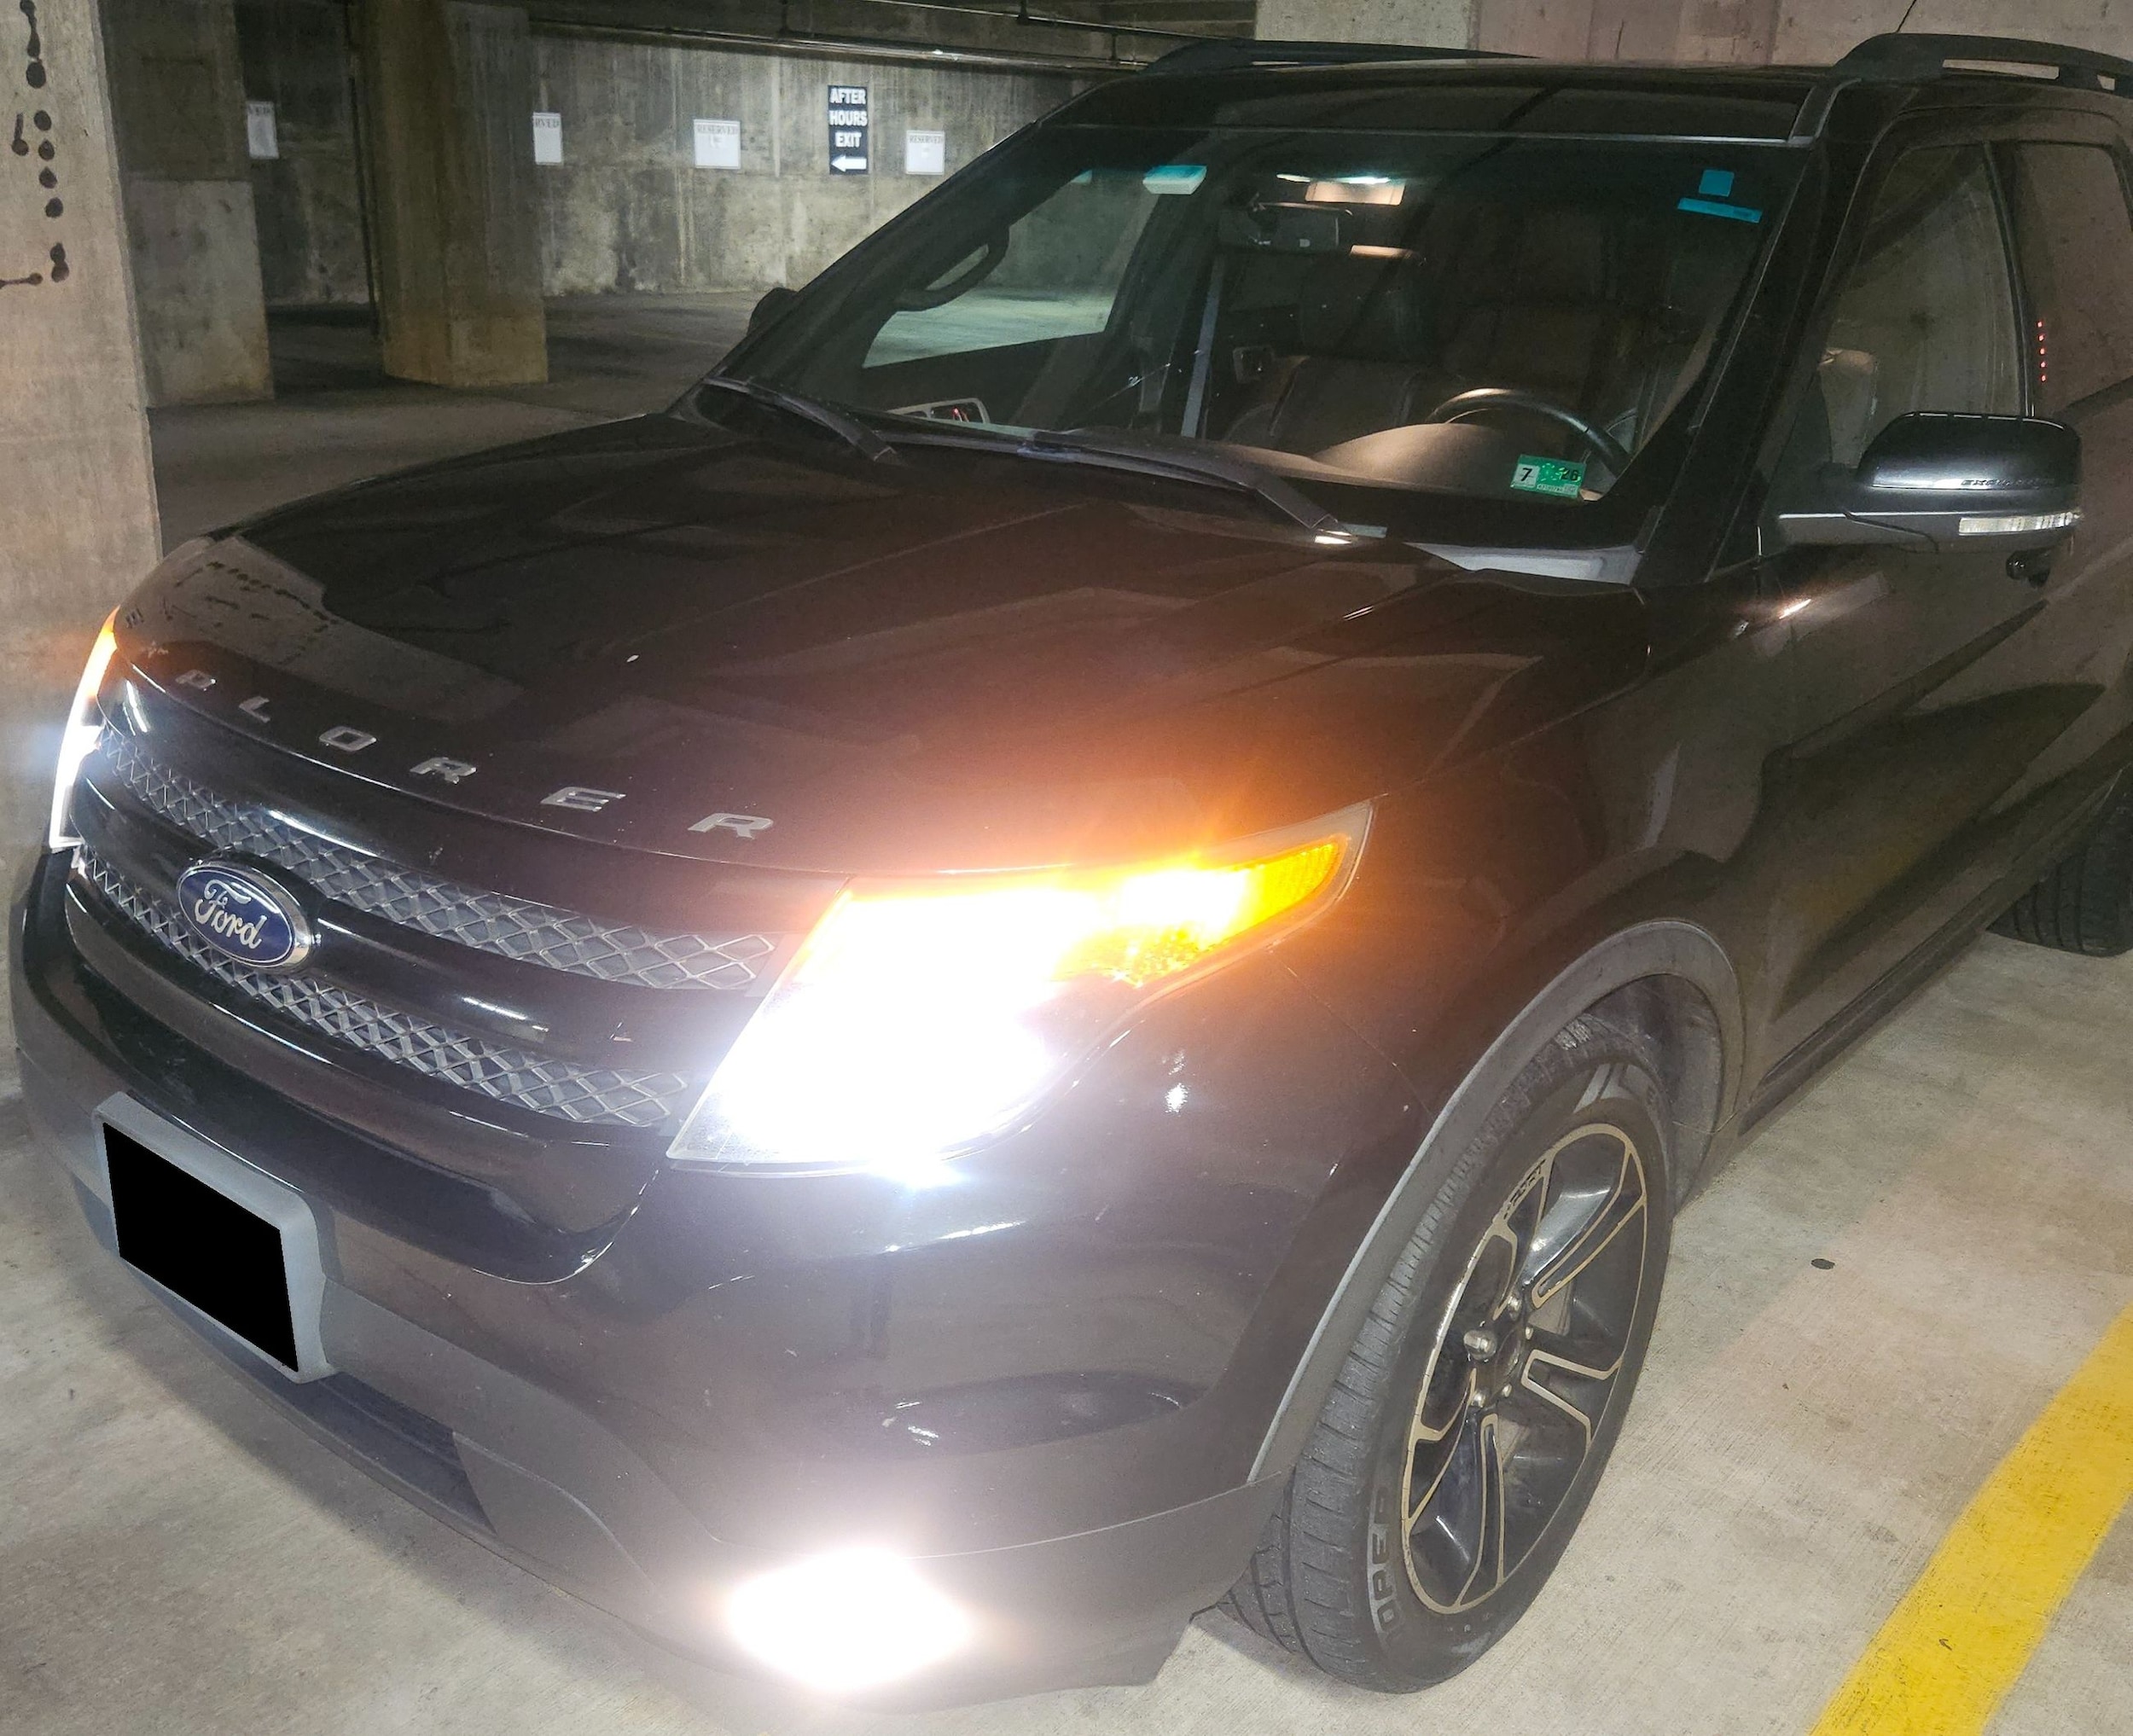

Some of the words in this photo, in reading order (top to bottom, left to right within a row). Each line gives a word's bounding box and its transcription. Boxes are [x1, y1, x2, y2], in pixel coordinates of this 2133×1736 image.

[829, 88, 866, 104] AFTER
[829, 110, 868, 126] HOURS
[835, 131, 862, 148] EXIT
[1520, 467, 1532, 481] 7
[195, 880, 268, 949] Ford
